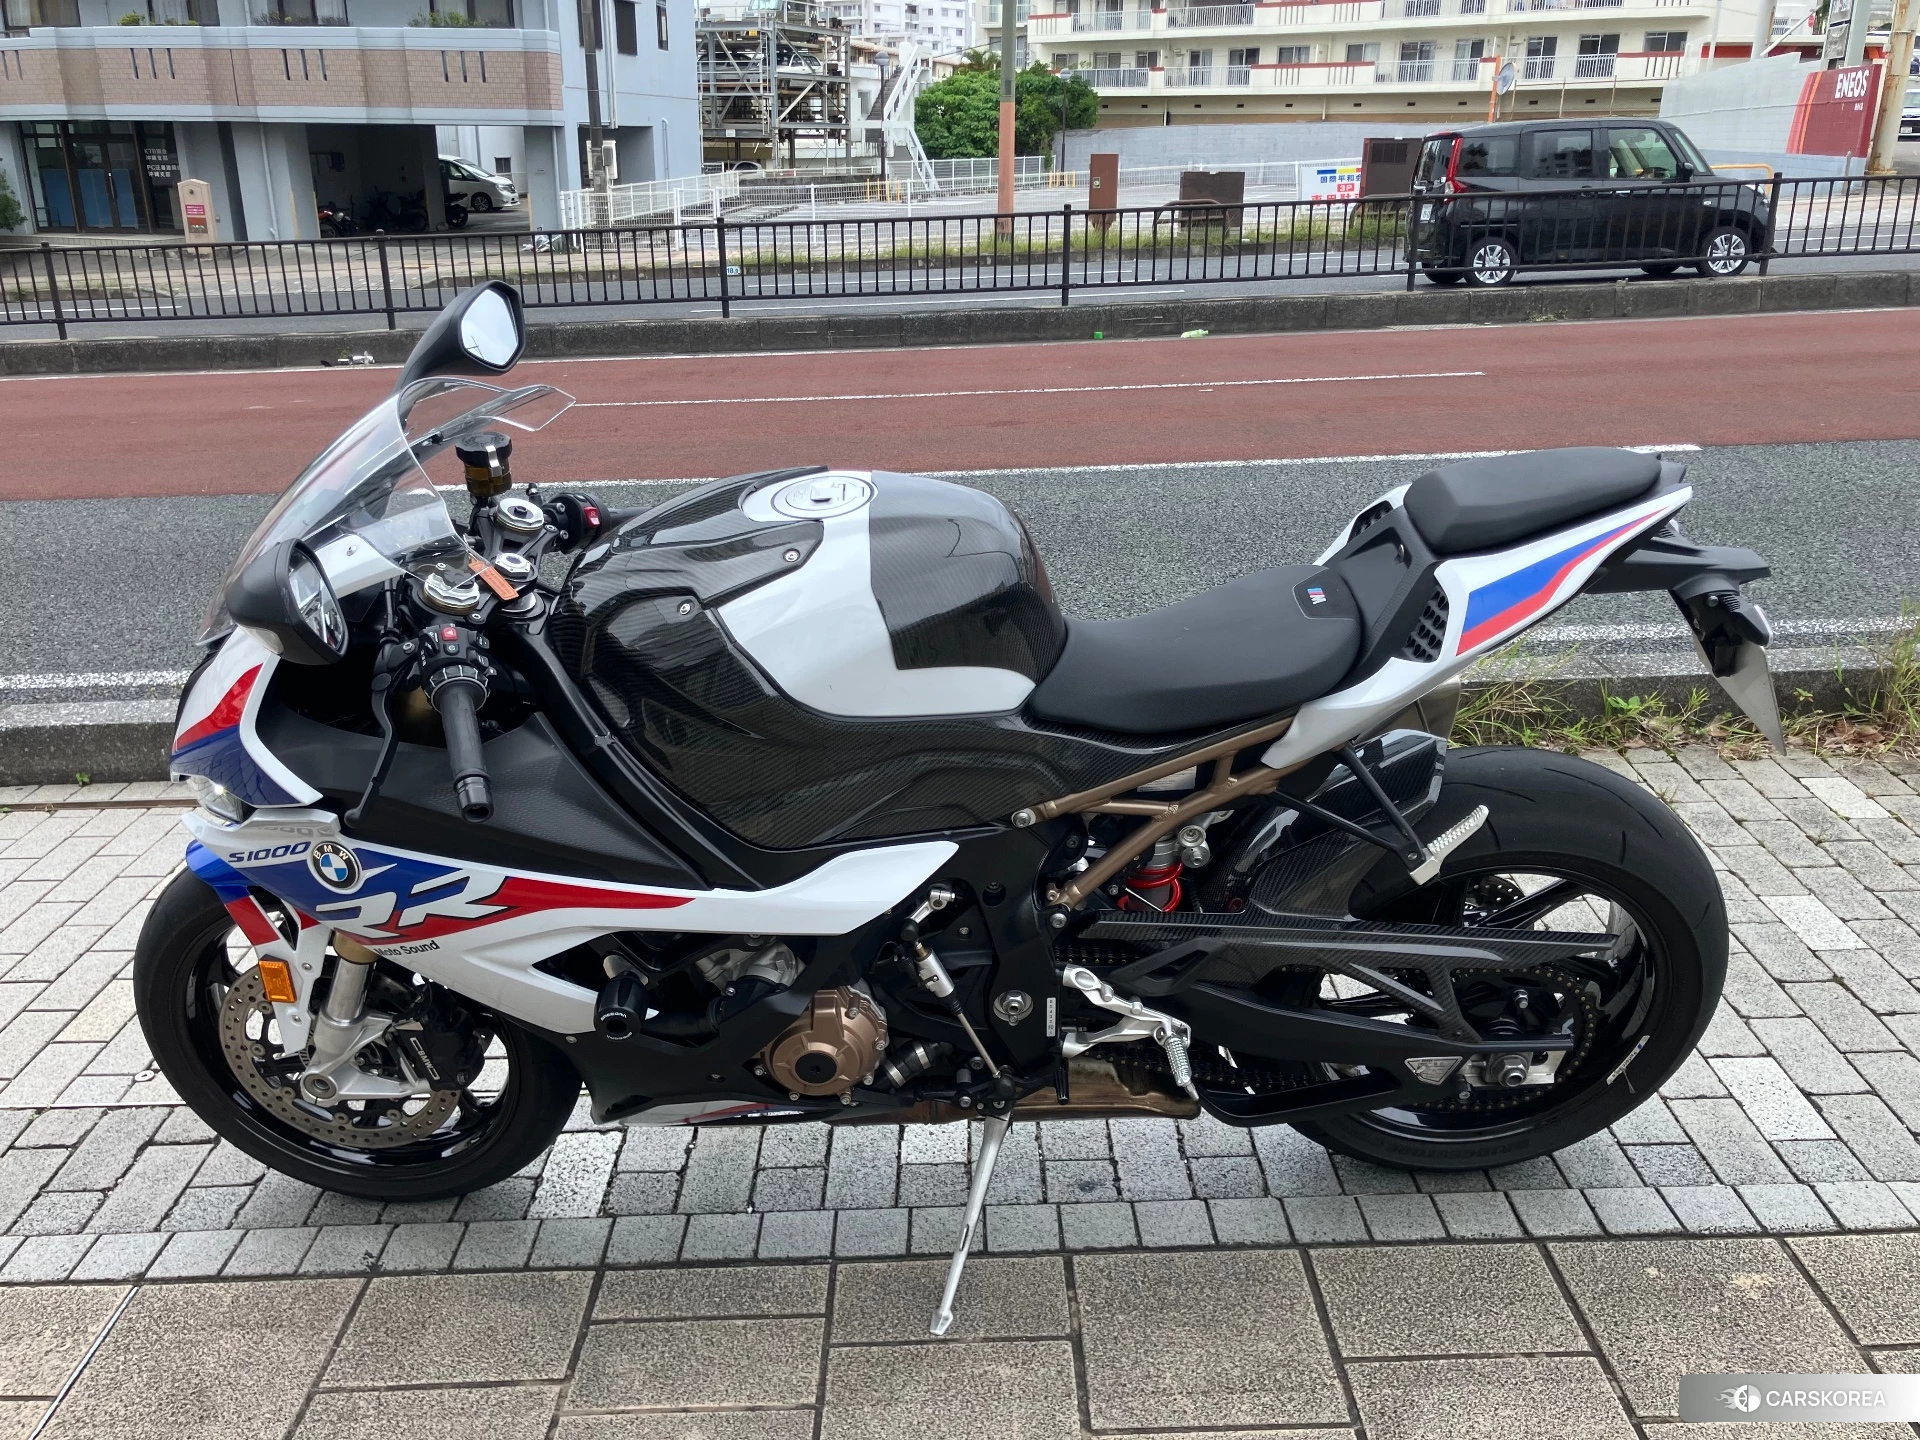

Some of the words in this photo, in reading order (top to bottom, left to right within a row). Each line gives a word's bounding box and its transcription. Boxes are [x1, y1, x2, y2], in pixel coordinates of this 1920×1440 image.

[1834, 69, 1870, 99] ENEOS
[228, 841, 312, 863] S1000
[313, 844, 350, 860] BMW
[399, 939, 441, 955] Sound
